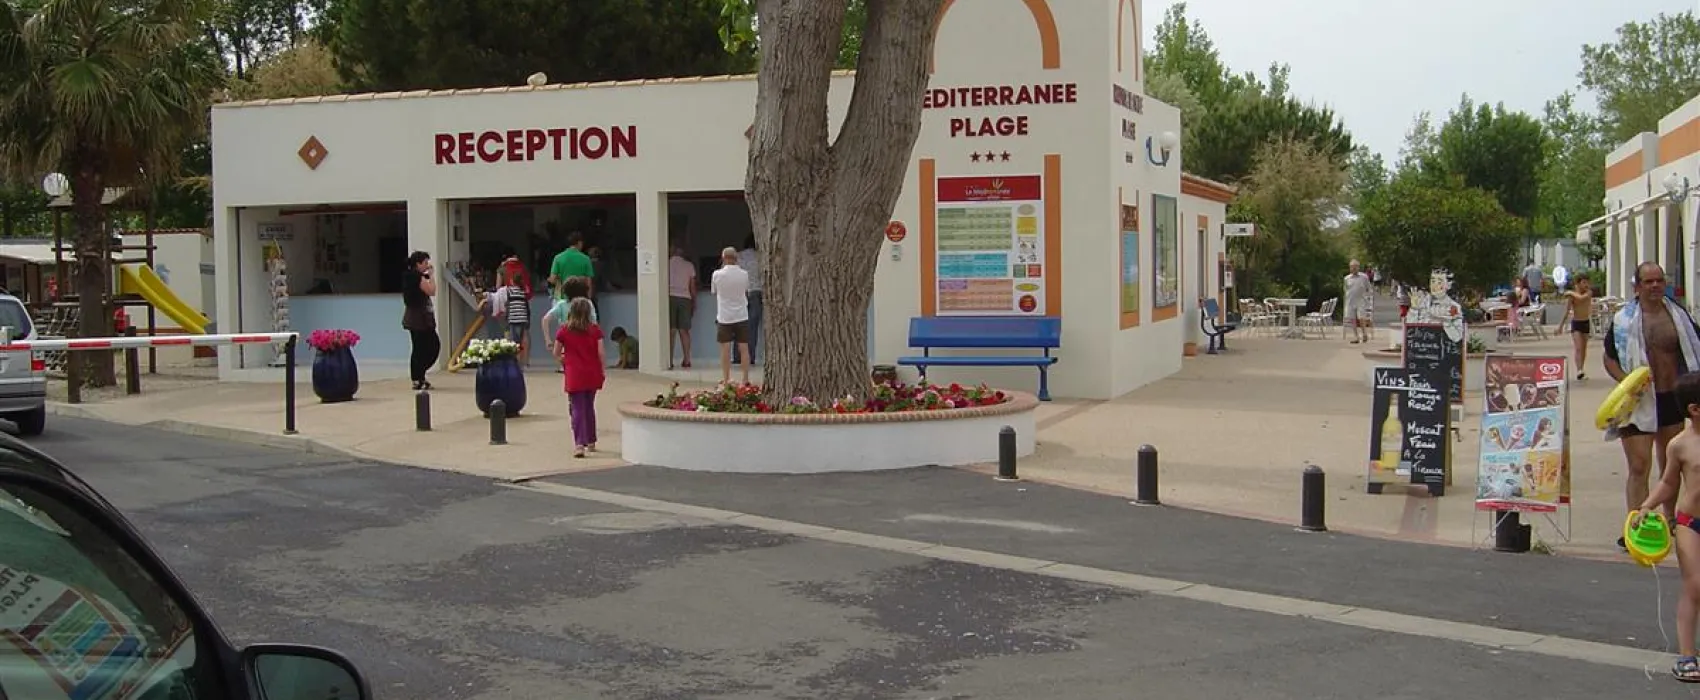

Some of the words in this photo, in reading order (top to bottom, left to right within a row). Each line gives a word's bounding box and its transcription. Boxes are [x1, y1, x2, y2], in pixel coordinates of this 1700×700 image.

[922, 83, 1077, 108] EDITERRANEE
[950, 116, 1029, 138] PLAGE
[434, 125, 637, 165] RECEPTION
